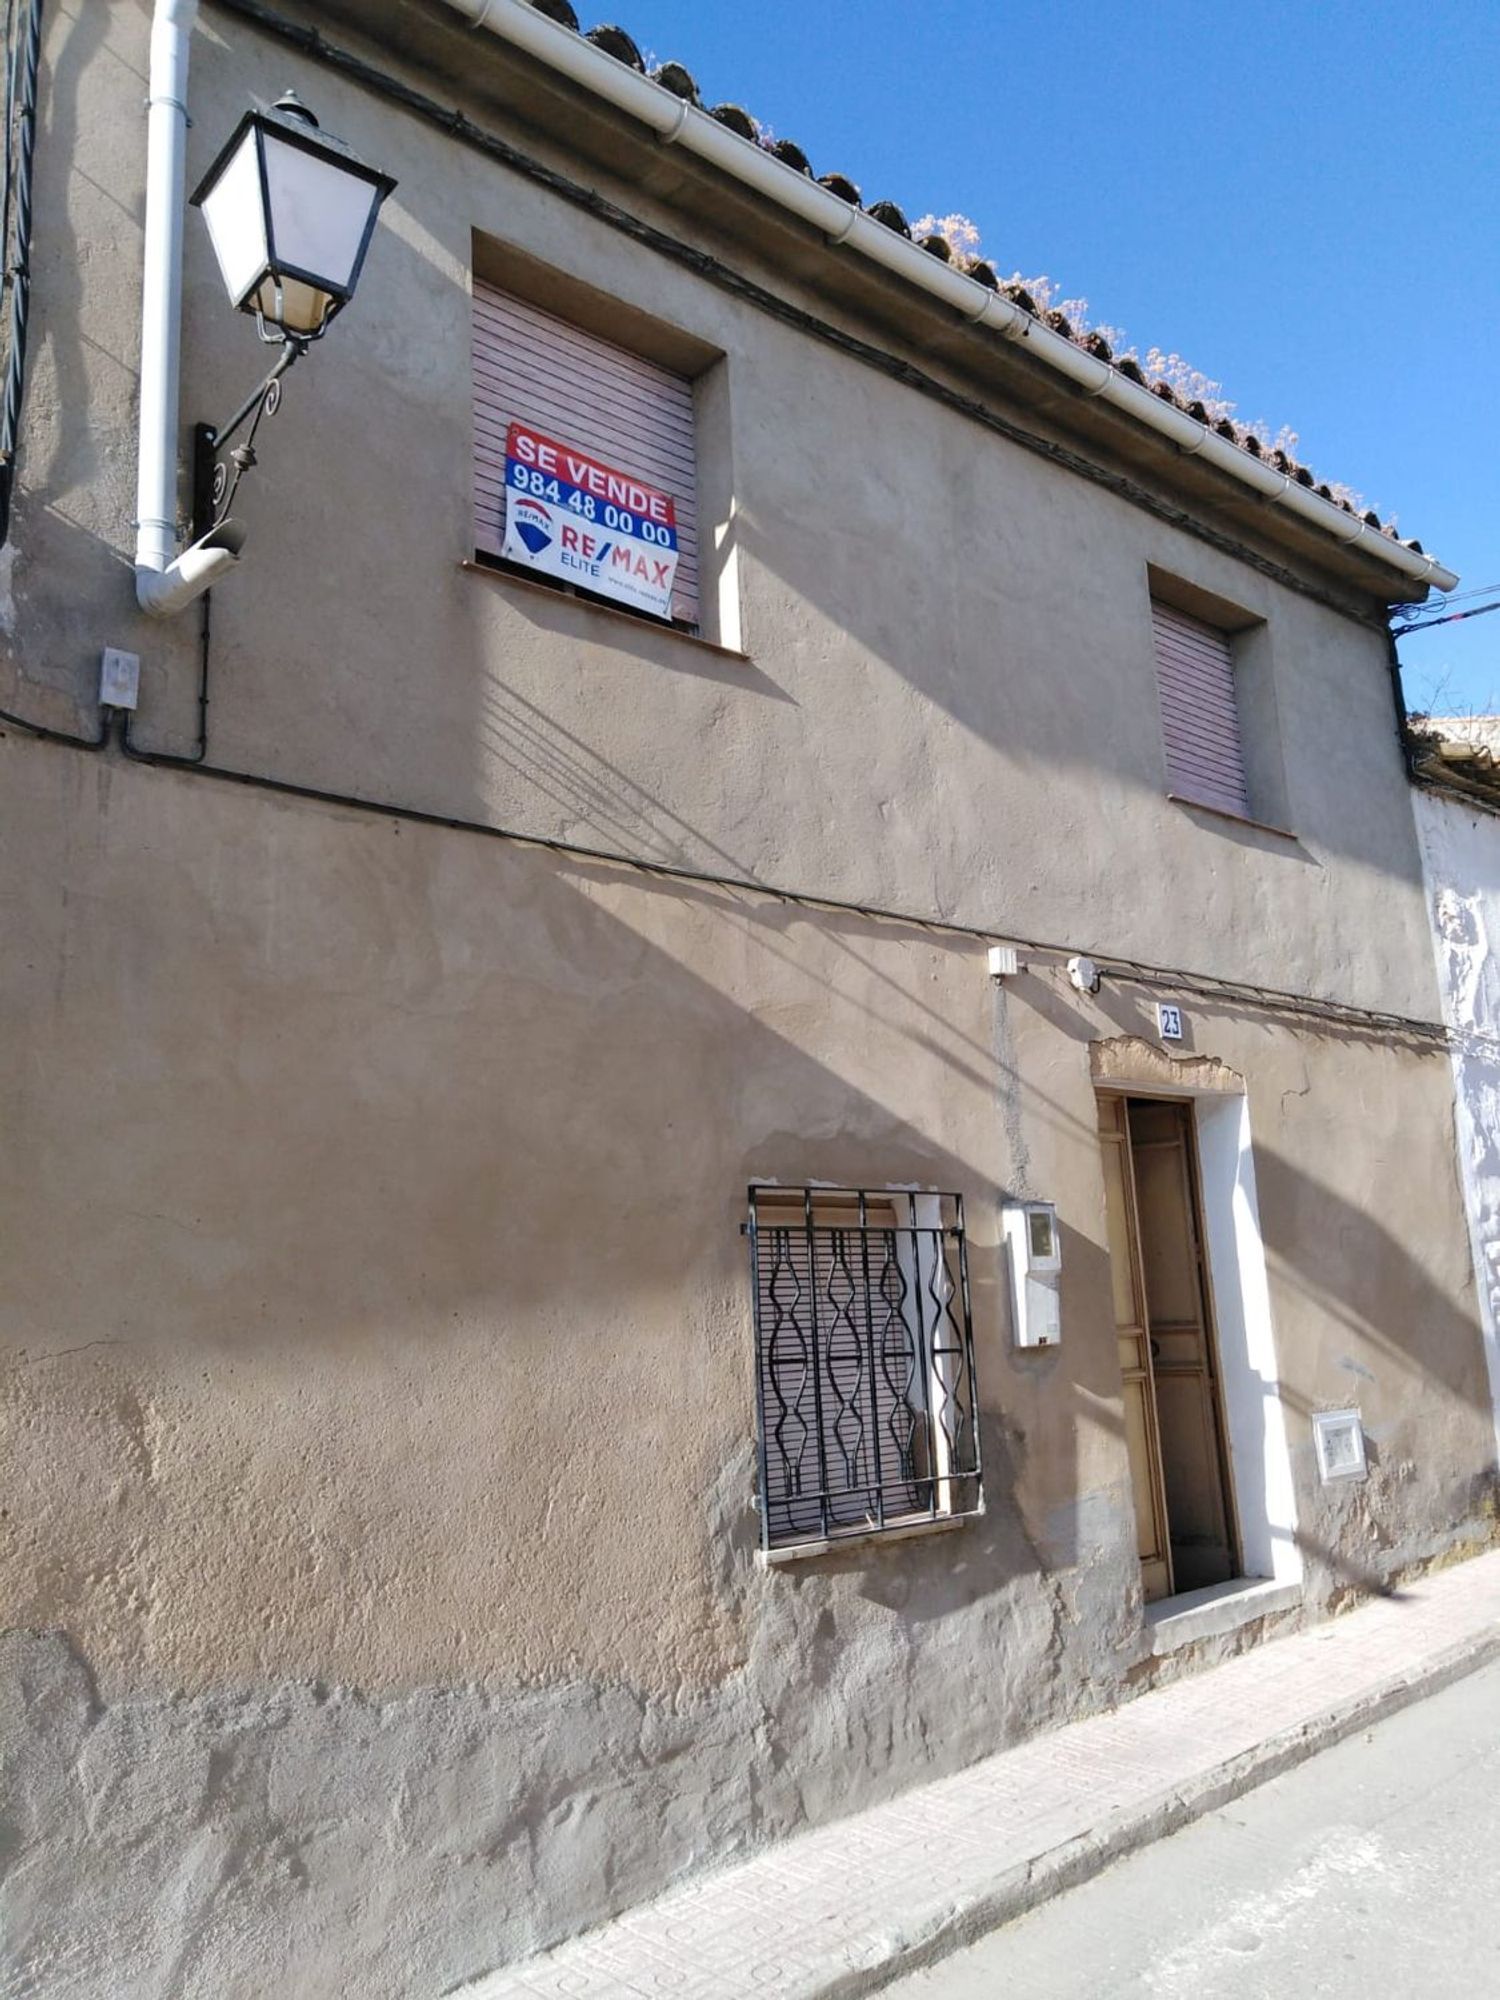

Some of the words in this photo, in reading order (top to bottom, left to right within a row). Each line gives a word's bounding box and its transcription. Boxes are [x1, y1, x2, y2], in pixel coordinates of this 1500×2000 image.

[513, 465, 560, 501] 984
[569, 491, 596, 519] 48
[604, 507, 634, 534] 00
[642, 522, 671, 547] 00
[516, 436, 557, 473] SE
[566, 457, 668, 521] VENDE
[561, 525, 671, 589] RE/MAX
[561, 553, 600, 577] ELITE
[1162, 1010, 1179, 1034] 23
